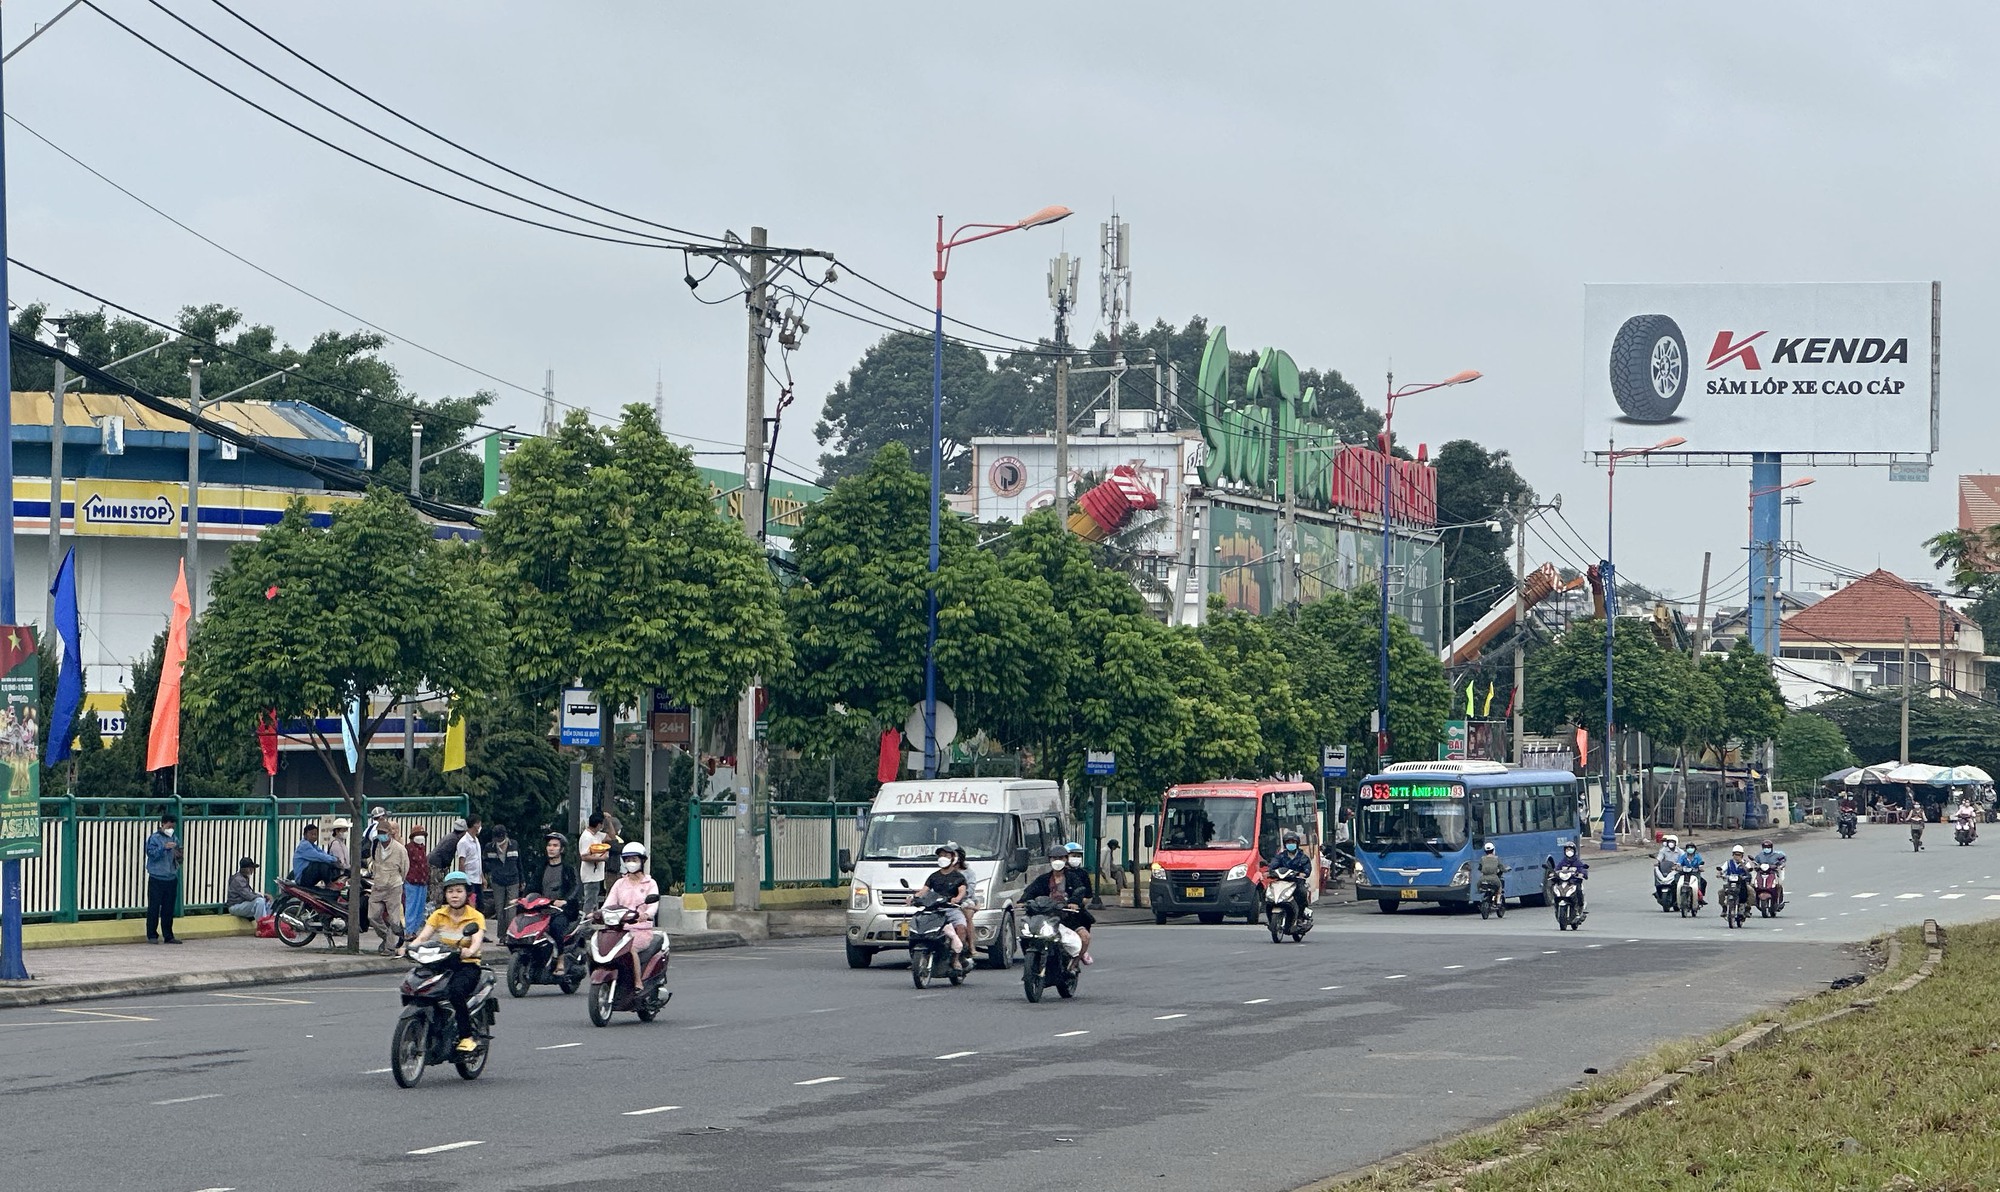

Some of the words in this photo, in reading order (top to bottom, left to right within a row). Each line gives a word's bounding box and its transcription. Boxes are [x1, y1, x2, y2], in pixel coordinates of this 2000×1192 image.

[1771, 338, 1908, 363] KENDA
[1706, 377, 1747, 395] SĂM
[1791, 380, 1817, 395] XE
[1821, 380, 1863, 395] CAO
[1866, 376, 1905, 395] CẤP
[93, 504, 127, 519] MINI
[130, 505, 167, 520] STOP
[659, 722, 684, 733] 24H
[896, 789, 934, 806] TOÀN
[939, 786, 988, 805] THẮNG
[1362, 787, 1371, 797] 93
[1453, 787, 1462, 797] 93
[0, 817, 39, 839] ASEAN
